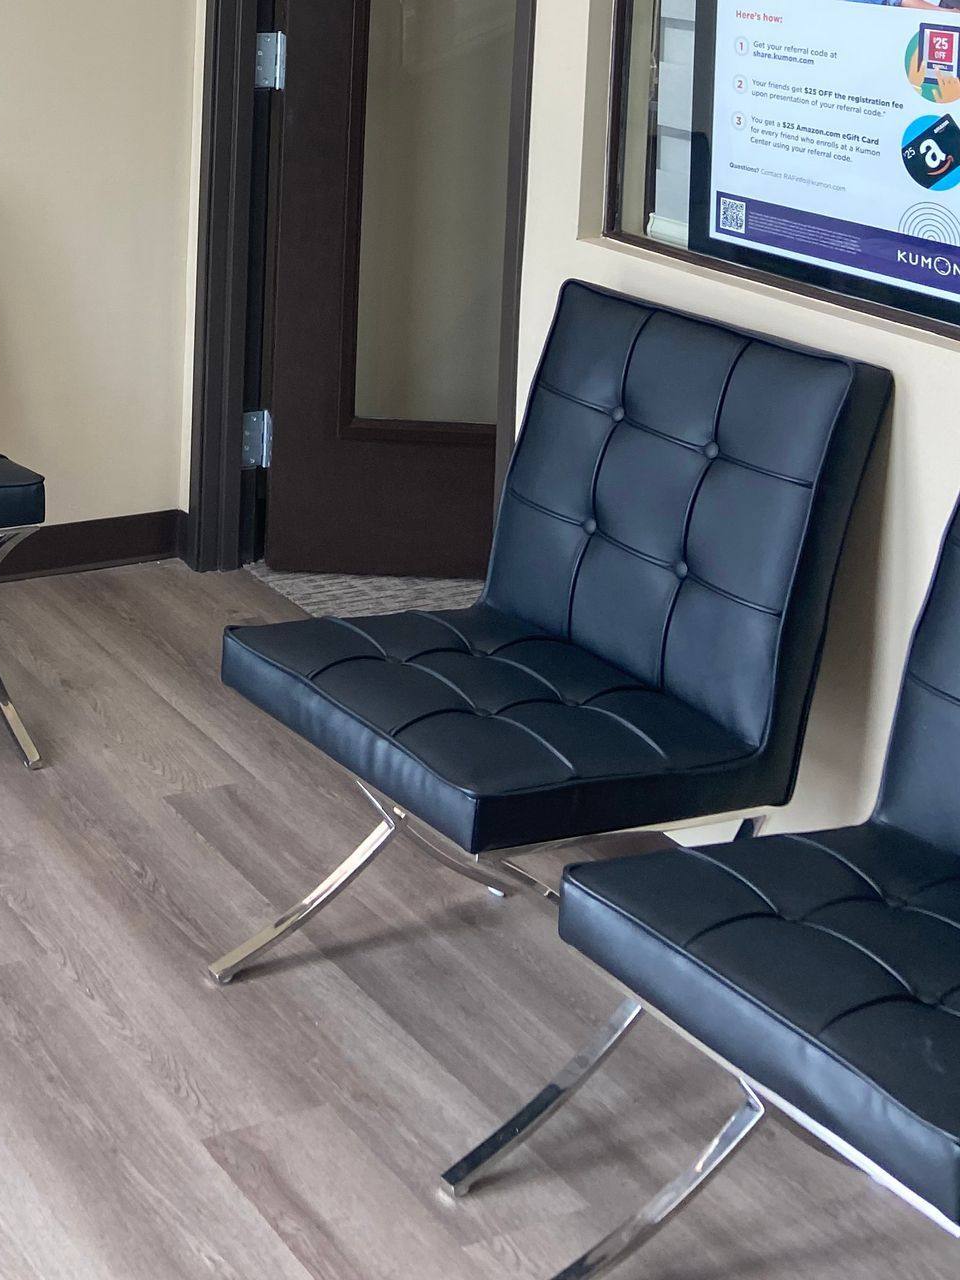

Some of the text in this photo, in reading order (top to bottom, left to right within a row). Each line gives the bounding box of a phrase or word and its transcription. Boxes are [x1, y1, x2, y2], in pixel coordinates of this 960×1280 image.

[735, 10, 783, 23] Here's how:
[753, 40, 838, 59] Get your referral code at
[932, 36, 949, 50] $25
[753, 50, 815, 65] share.kumon.com
[934, 51, 946, 60] OFF
[737, 80, 743, 89] 2
[751, 79, 904, 110] Your friends get $25 OFF the registration fee
[751, 90, 768, 100] upon
[769, 92, 810, 105] presentation
[810, 99, 818, 107] of
[819, 102, 835, 111] your
[836, 104, 862, 114] referral
[735, 116, 742, 126] 3
[751, 115, 763, 124] You
[764, 118, 775, 128] get
[782, 121, 795, 130] $25
[795, 124, 841, 139] Amazon.com
[842, 132, 860, 143] eGift
[861, 135, 880, 146] Card
[750, 136, 772, 147] Center
[772, 141, 790, 152] using
[791, 144, 806, 154] your
[807, 148, 832, 159] referral
[751, 126, 759, 134] for
[760, 129, 779, 139] every
[780, 131, 799, 141] friend
[800, 135, 815, 144] who
[816, 139, 839, 150] enrolls
[840, 143, 848, 151] at
[855, 145, 881, 157] Kumon
[729, 161, 760, 174] Questions?
[897, 249, 960, 276] KUMON
